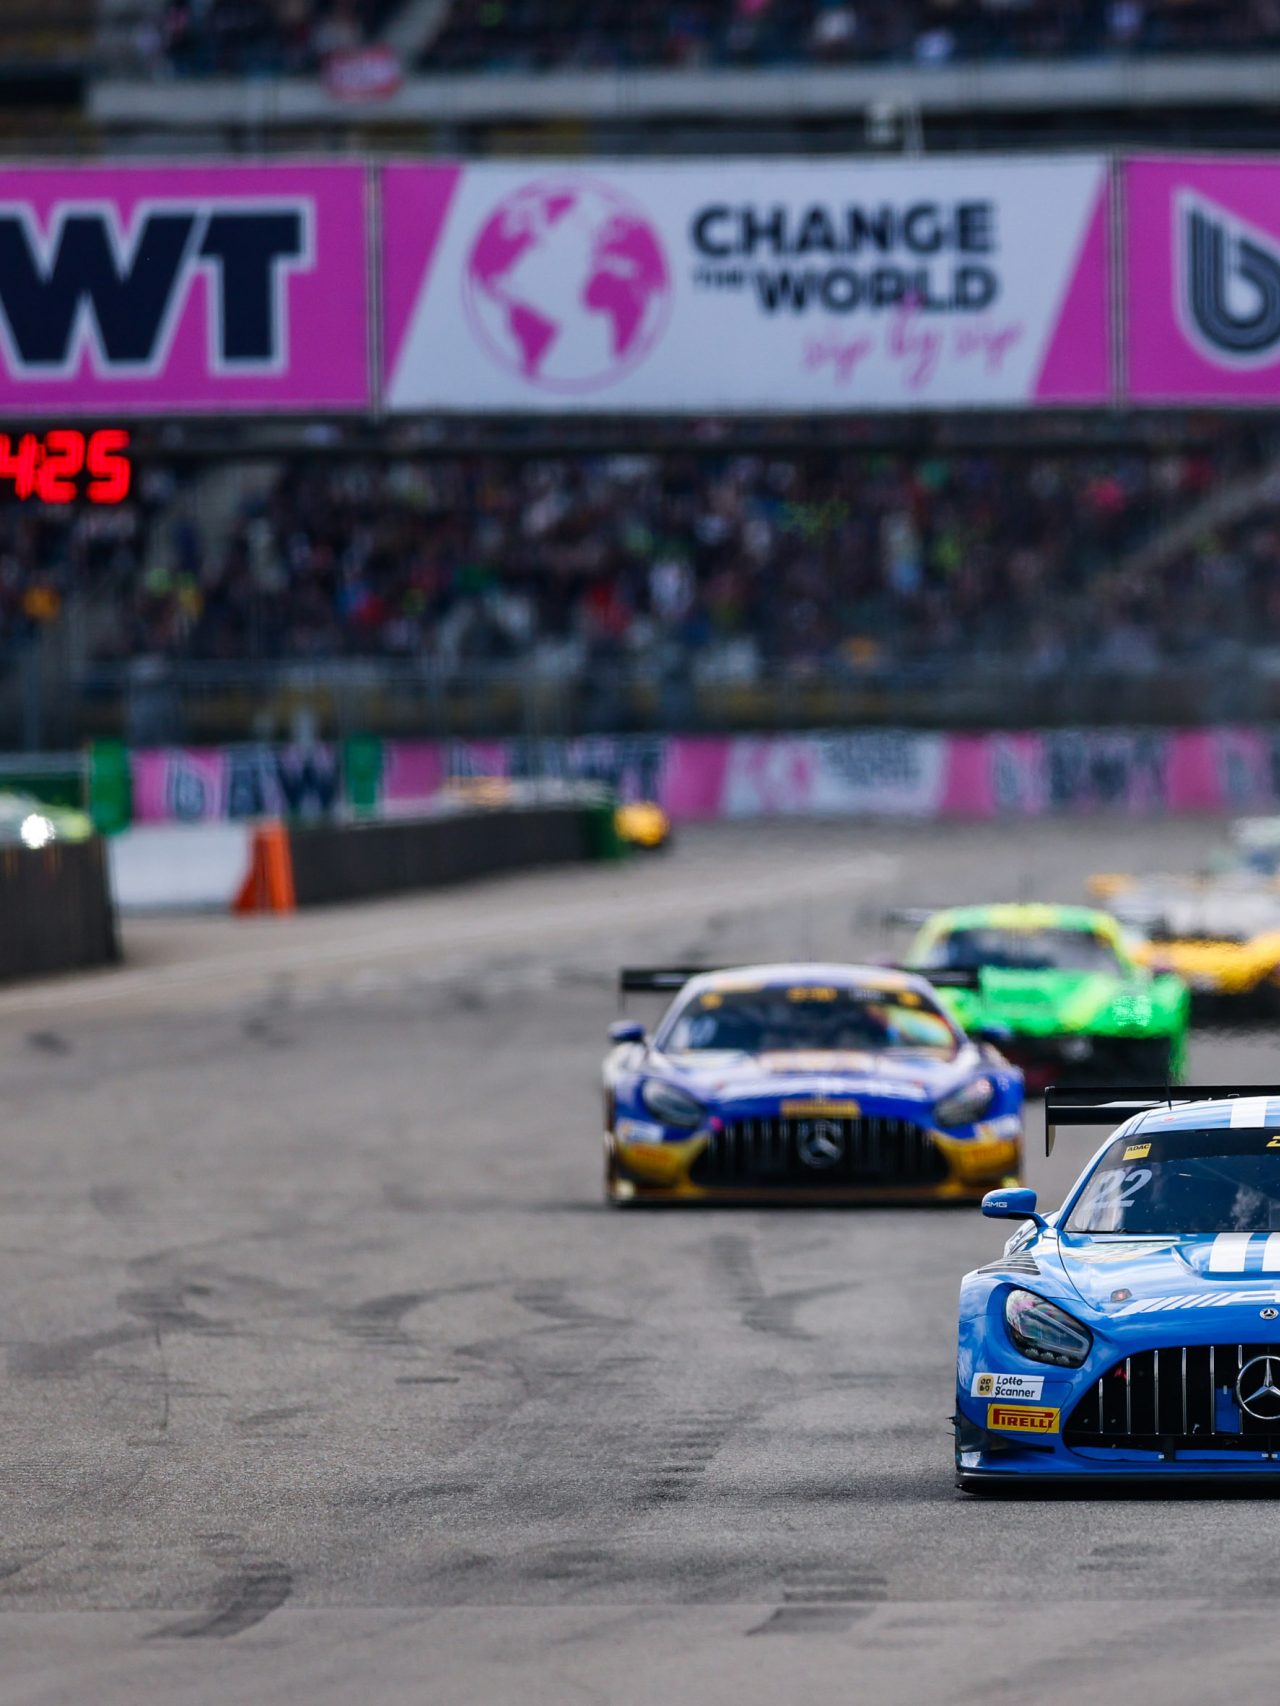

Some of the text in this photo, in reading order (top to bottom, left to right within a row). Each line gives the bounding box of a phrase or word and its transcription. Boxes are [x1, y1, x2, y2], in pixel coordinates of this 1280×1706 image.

[690, 202, 996, 256] CHANGE
[0, 198, 312, 376] WT
[754, 264, 1000, 312] WORLD
[1127, 1144, 1150, 1152] ADAC
[996, 1375, 1023, 1386] Lotto
[995, 1386, 1035, 1397] Scanner
[992, 1408, 1054, 1428] PIRELLI
